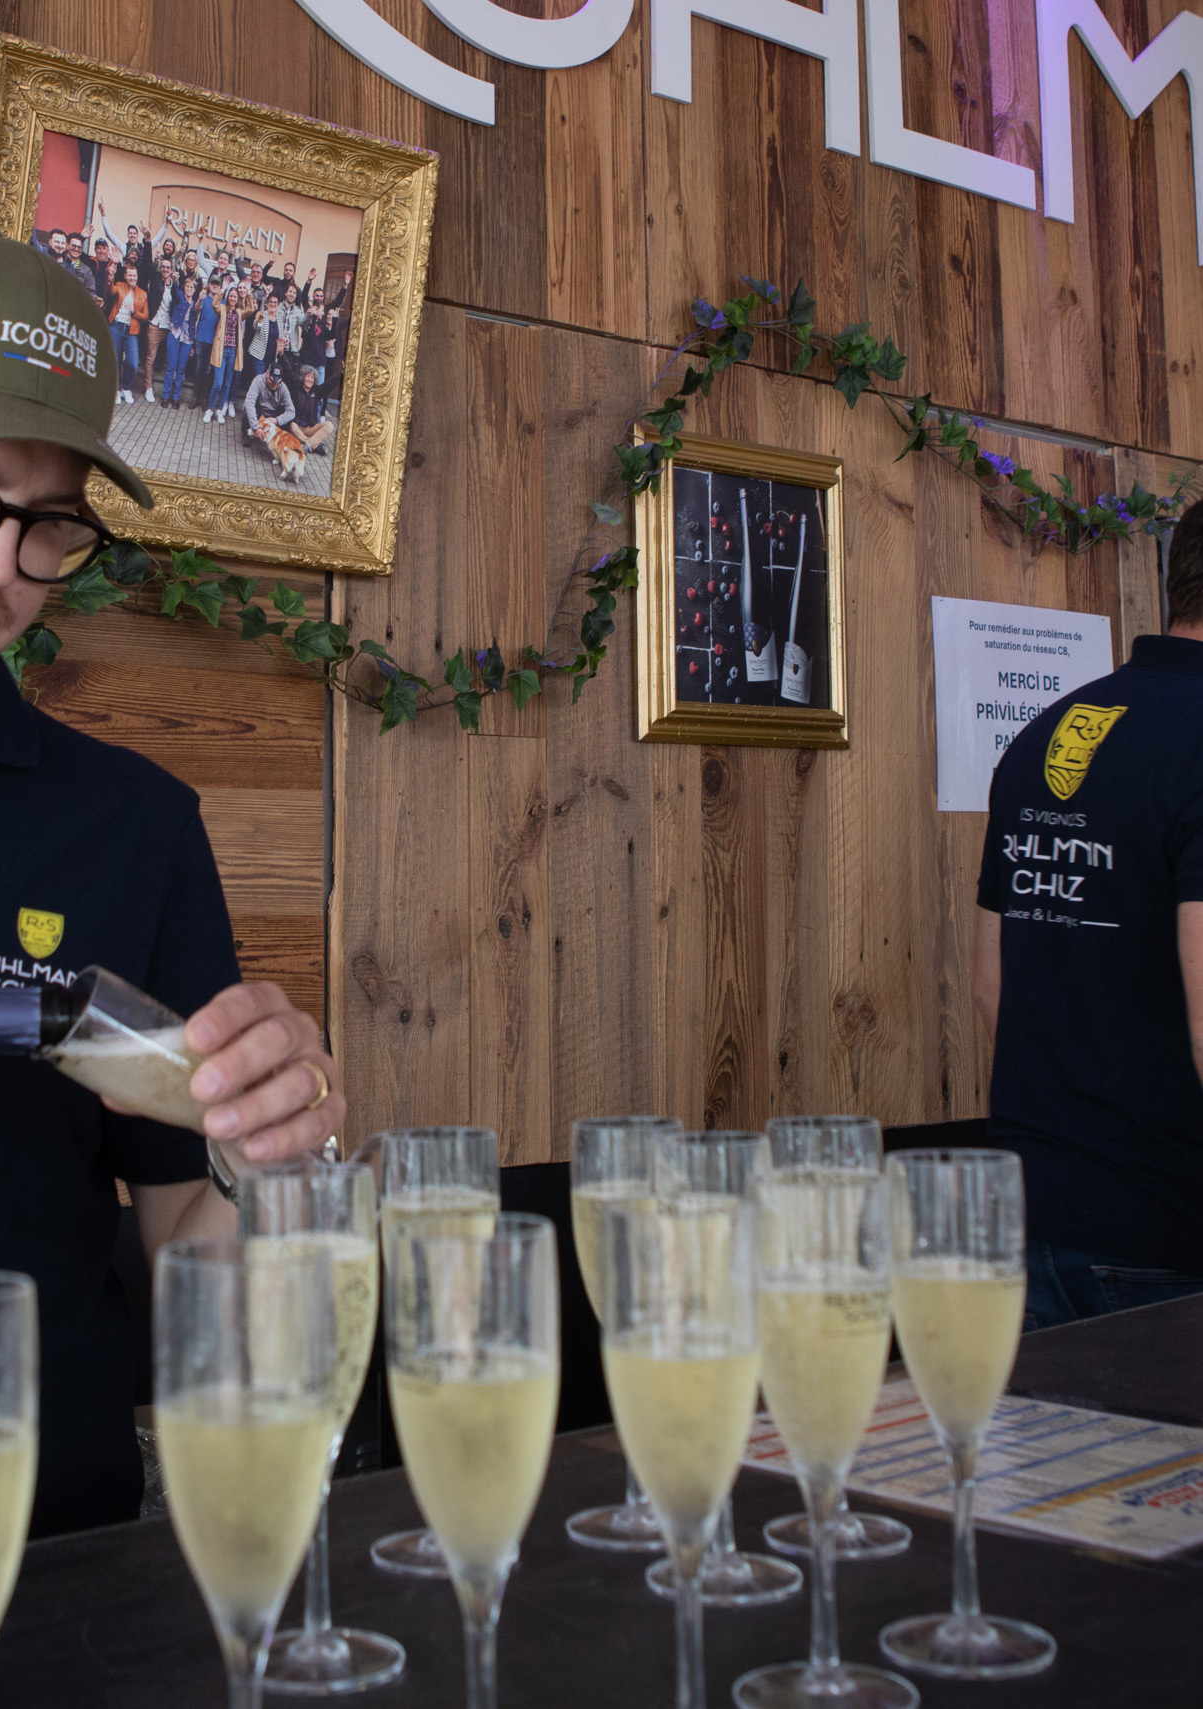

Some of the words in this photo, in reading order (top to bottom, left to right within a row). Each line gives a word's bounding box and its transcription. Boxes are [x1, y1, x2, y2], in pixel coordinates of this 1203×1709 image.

[45, 312, 98, 357] CHASSE
[969, 620, 987, 631] Pour
[988, 624, 1021, 635] remédier
[1022, 628, 1035, 636] aux
[1036, 629, 1073, 640] problèmes
[1074, 632, 1083, 641] de
[984, 640, 1021, 651] saturation
[1022, 643, 1032, 653] du
[1033, 644, 1057, 655] réseau
[1043, 675, 1060, 692] DE
